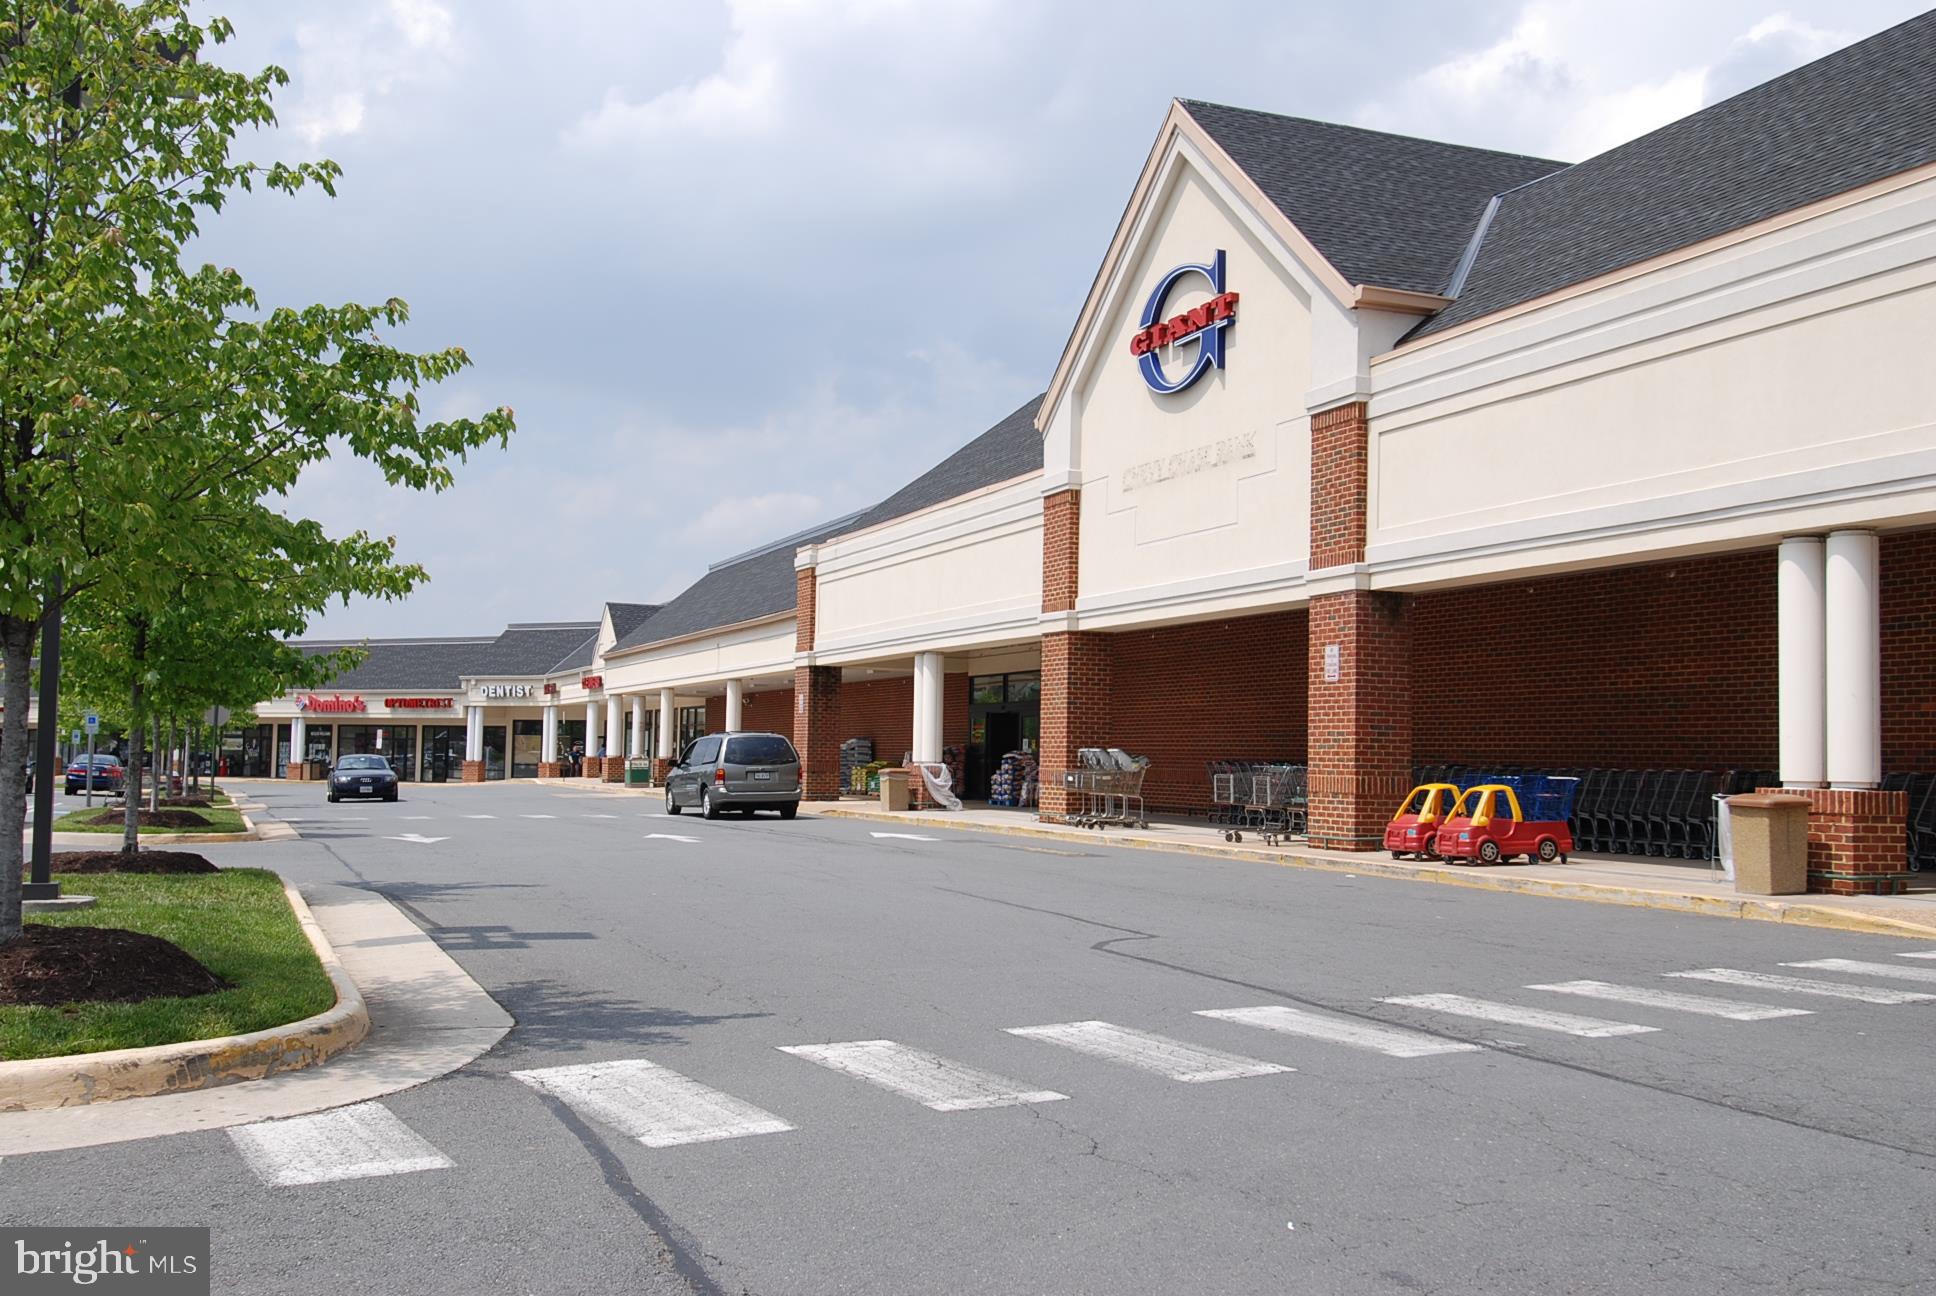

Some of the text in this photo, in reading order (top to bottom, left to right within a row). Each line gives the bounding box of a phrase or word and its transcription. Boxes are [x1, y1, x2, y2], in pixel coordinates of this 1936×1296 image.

[1130, 291, 1240, 357] GIANT
[480, 685, 533, 698] DENTIST
[307, 693, 367, 713] Domino's
